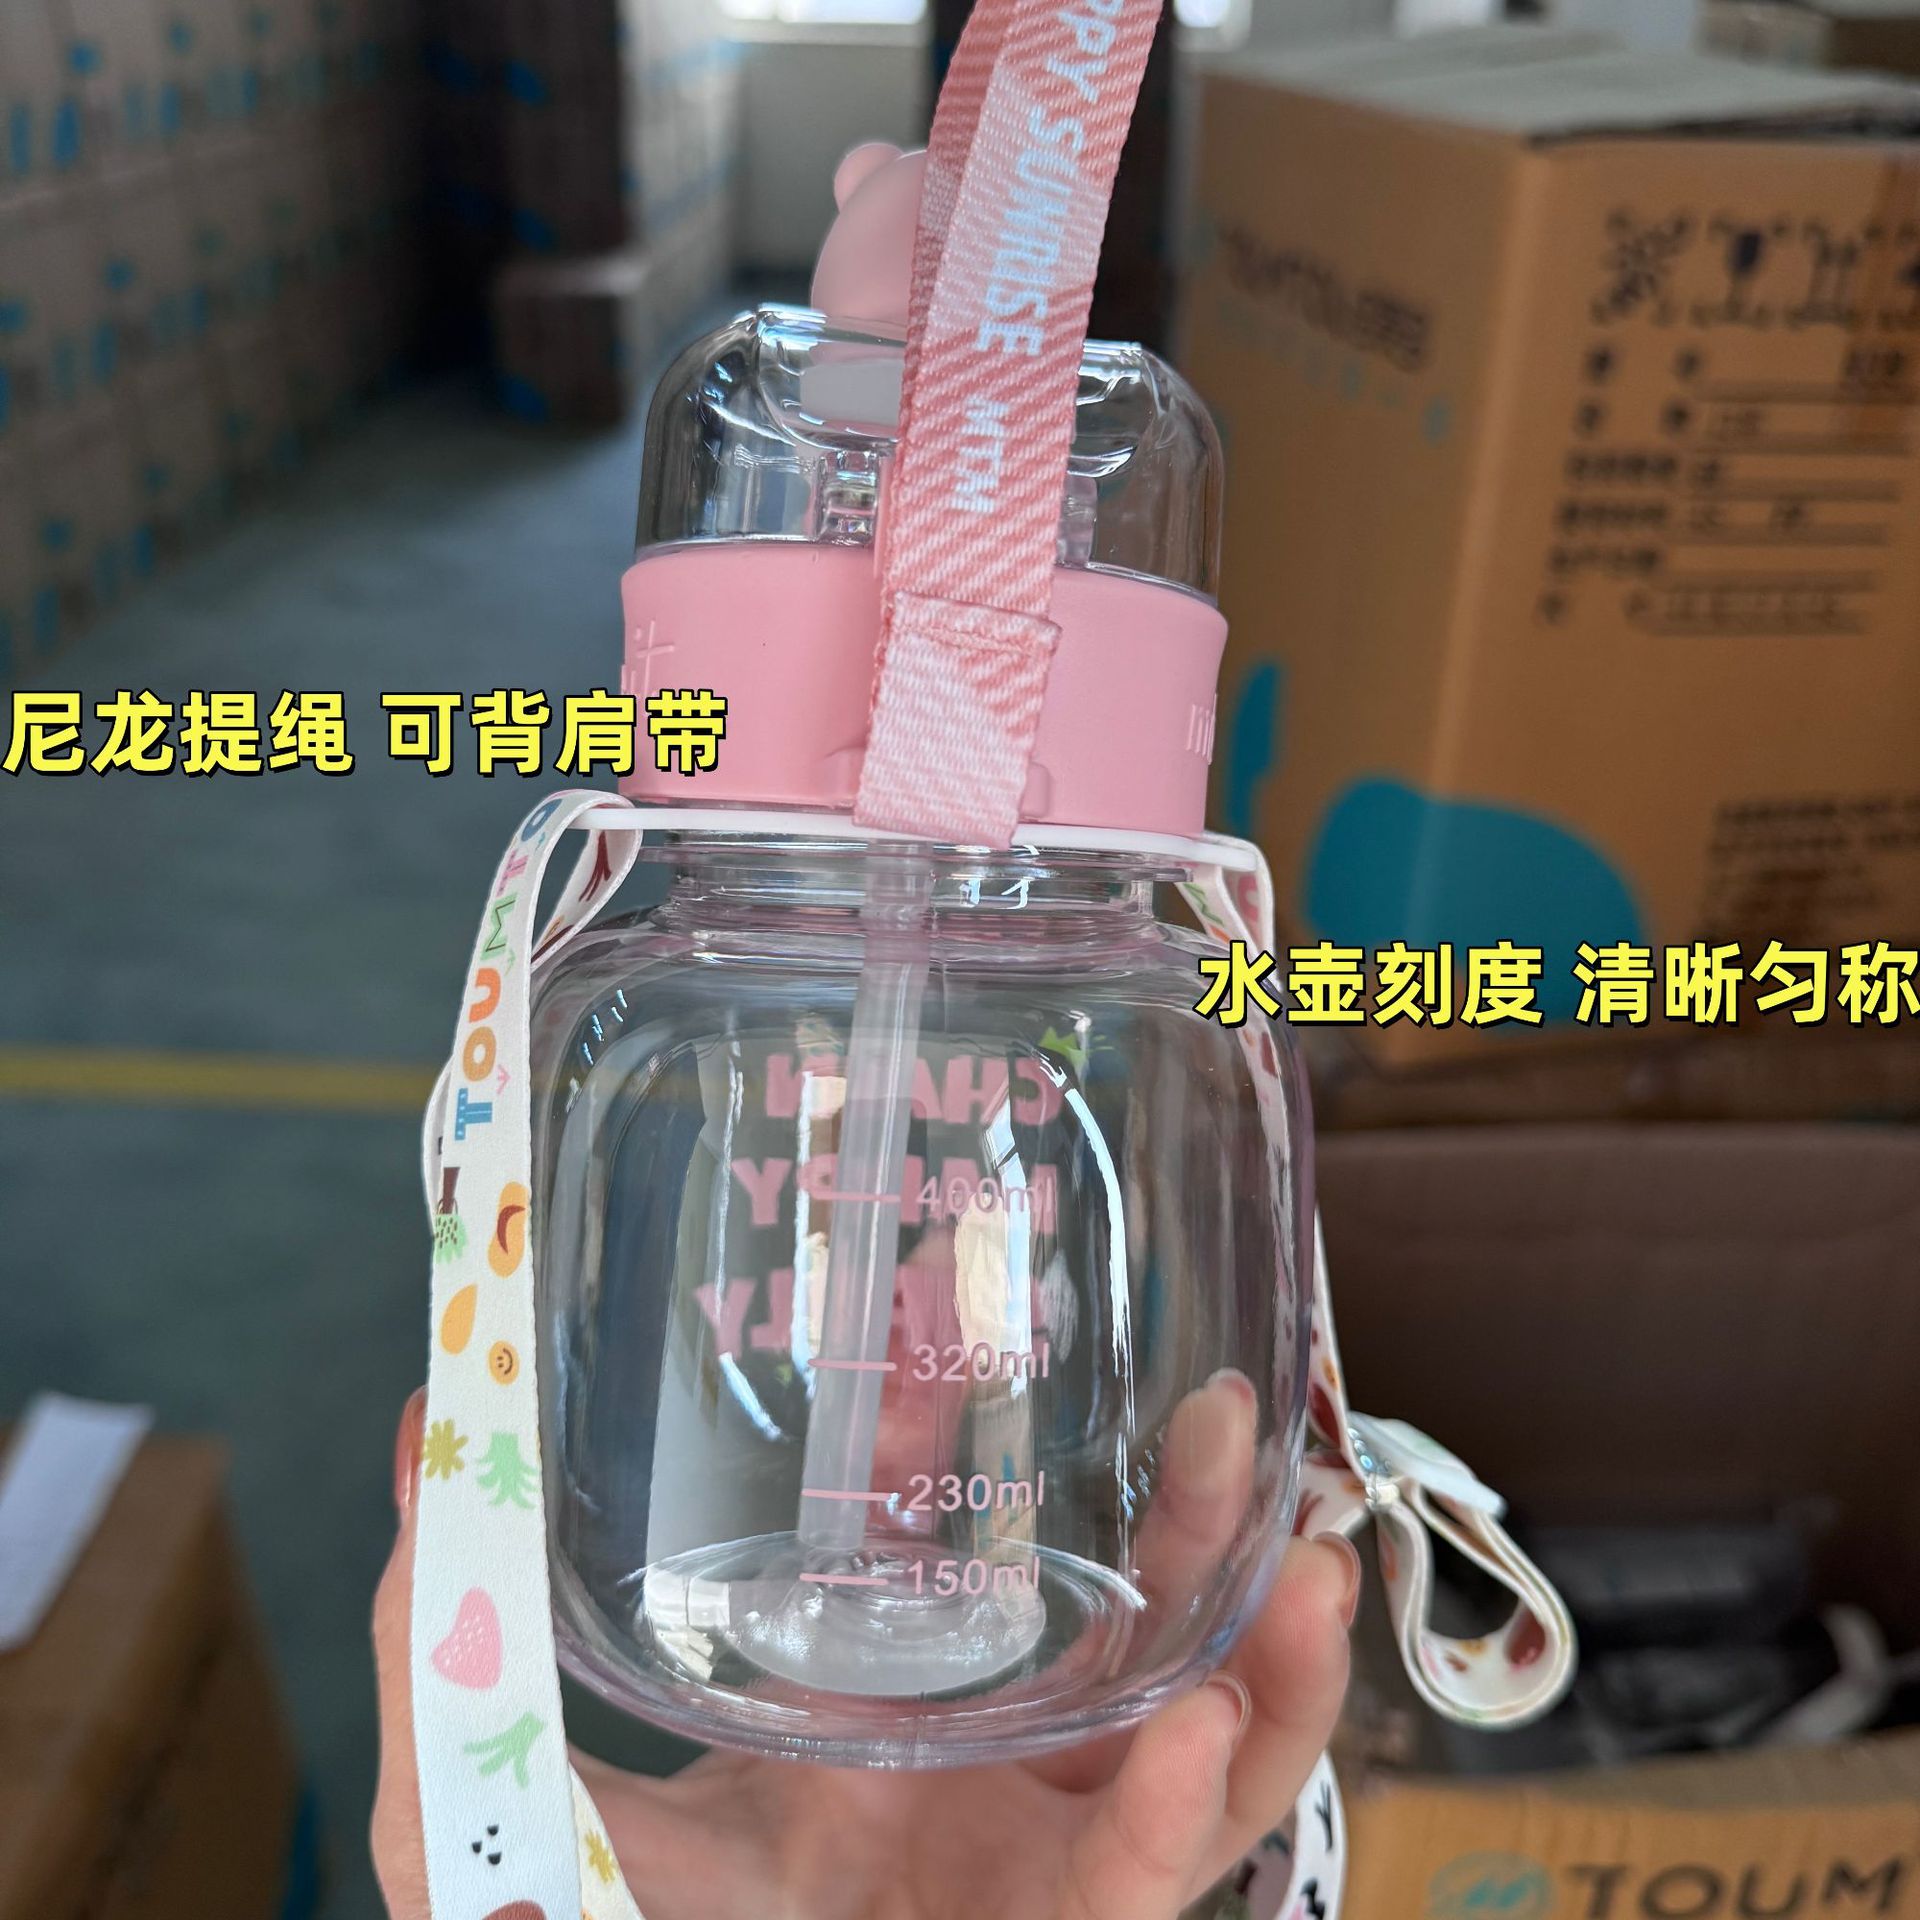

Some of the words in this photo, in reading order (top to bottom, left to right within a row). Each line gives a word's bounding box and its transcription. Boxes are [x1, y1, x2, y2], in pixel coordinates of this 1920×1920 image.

[976, 104, 1084, 356] SUNRISE
[917, 1176, 1053, 1214] 400ml
[912, 1340, 1050, 1381] 320ml
[907, 1470, 1045, 1511] 230ml
[907, 1556, 1041, 1597] 150ml
